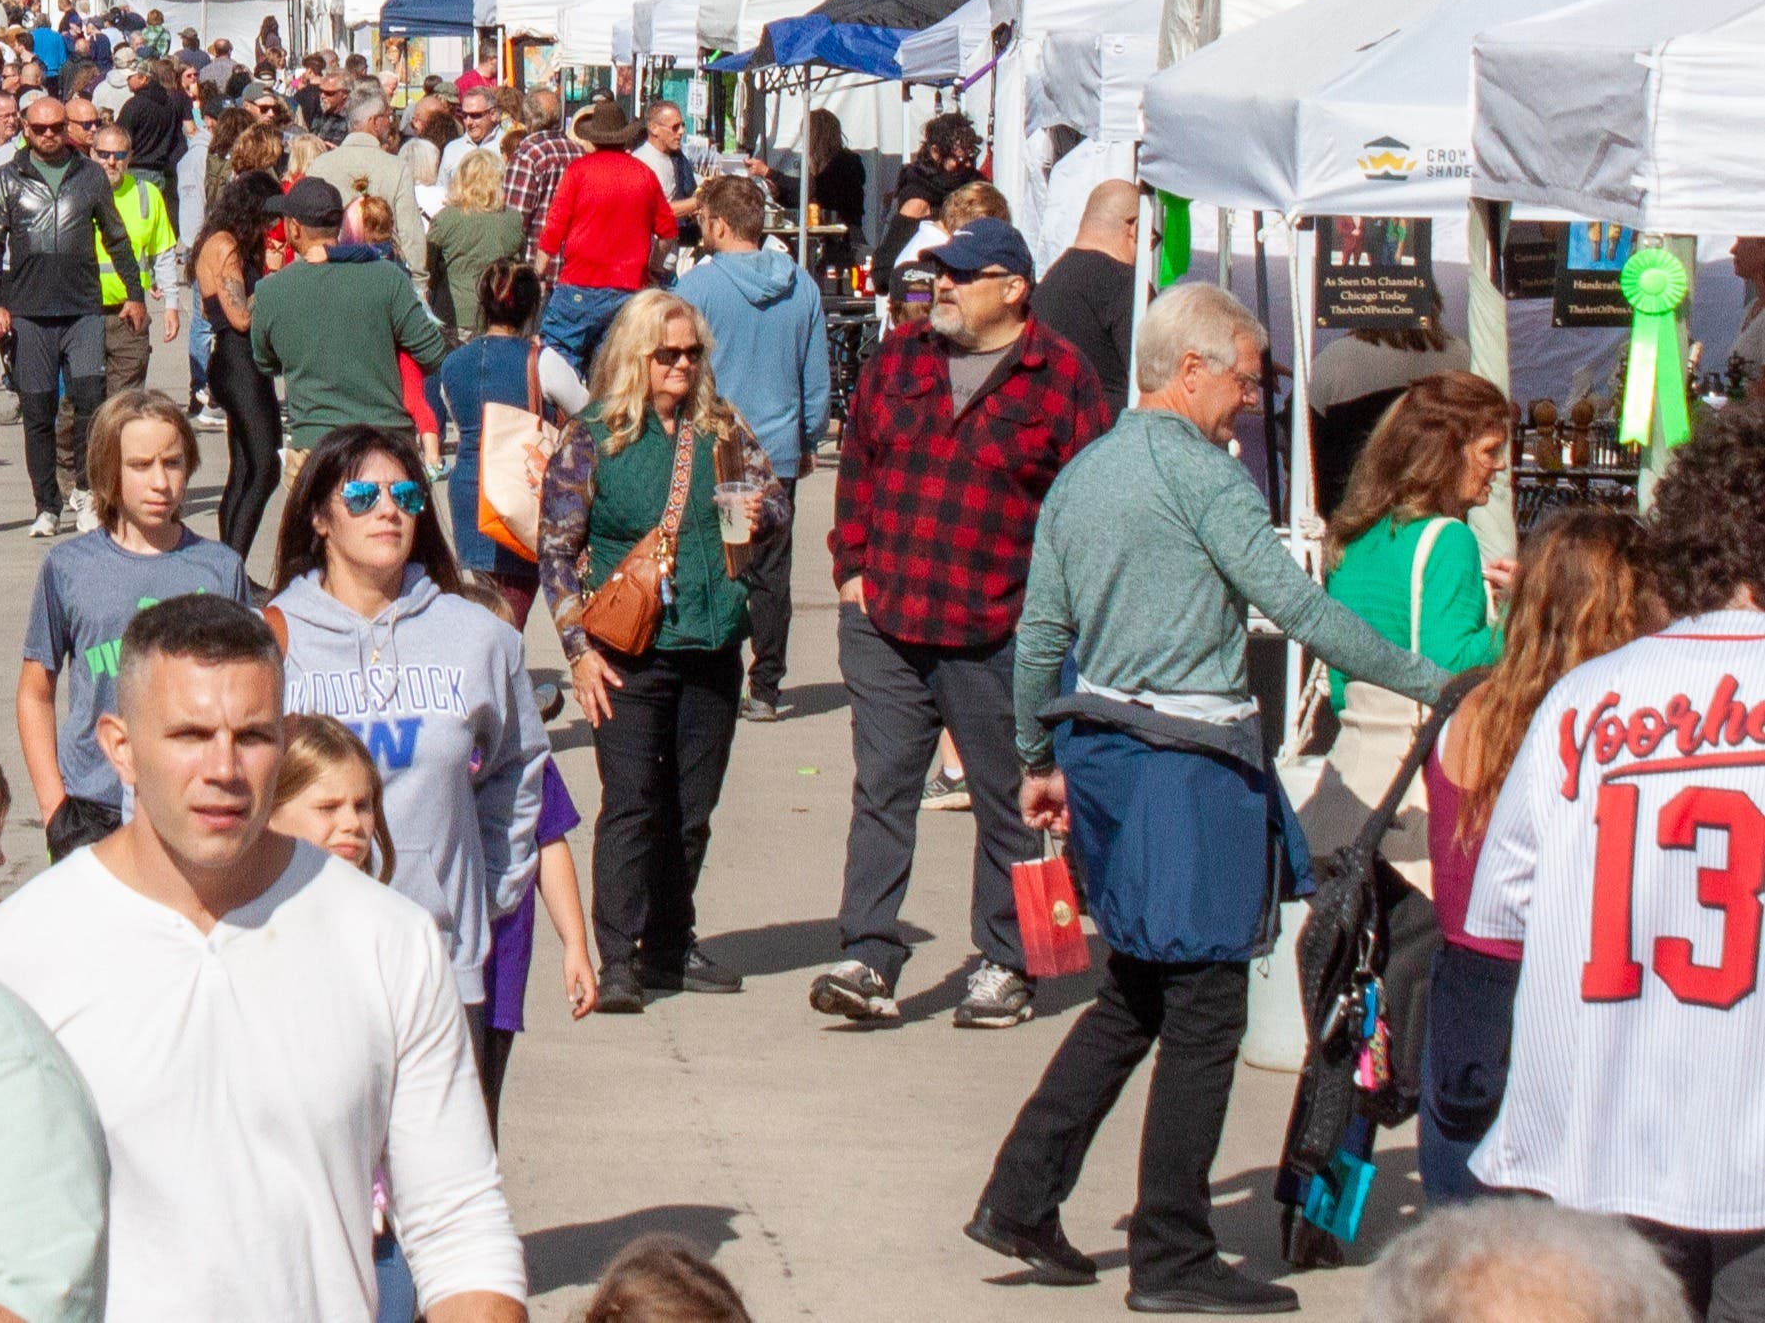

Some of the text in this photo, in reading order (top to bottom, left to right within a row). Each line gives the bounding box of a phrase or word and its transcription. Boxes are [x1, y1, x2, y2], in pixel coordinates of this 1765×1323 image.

[1324, 277, 1336, 286] As
[1337, 277, 1360, 286] Seen
[1361, 277, 1376, 286] On
[1377, 277, 1418, 287] Channel
[1340, 290, 1408, 302] Chicago Today
[286, 664, 471, 719] WOODSTOCK
[1581, 783, 1765, 1011] 13
